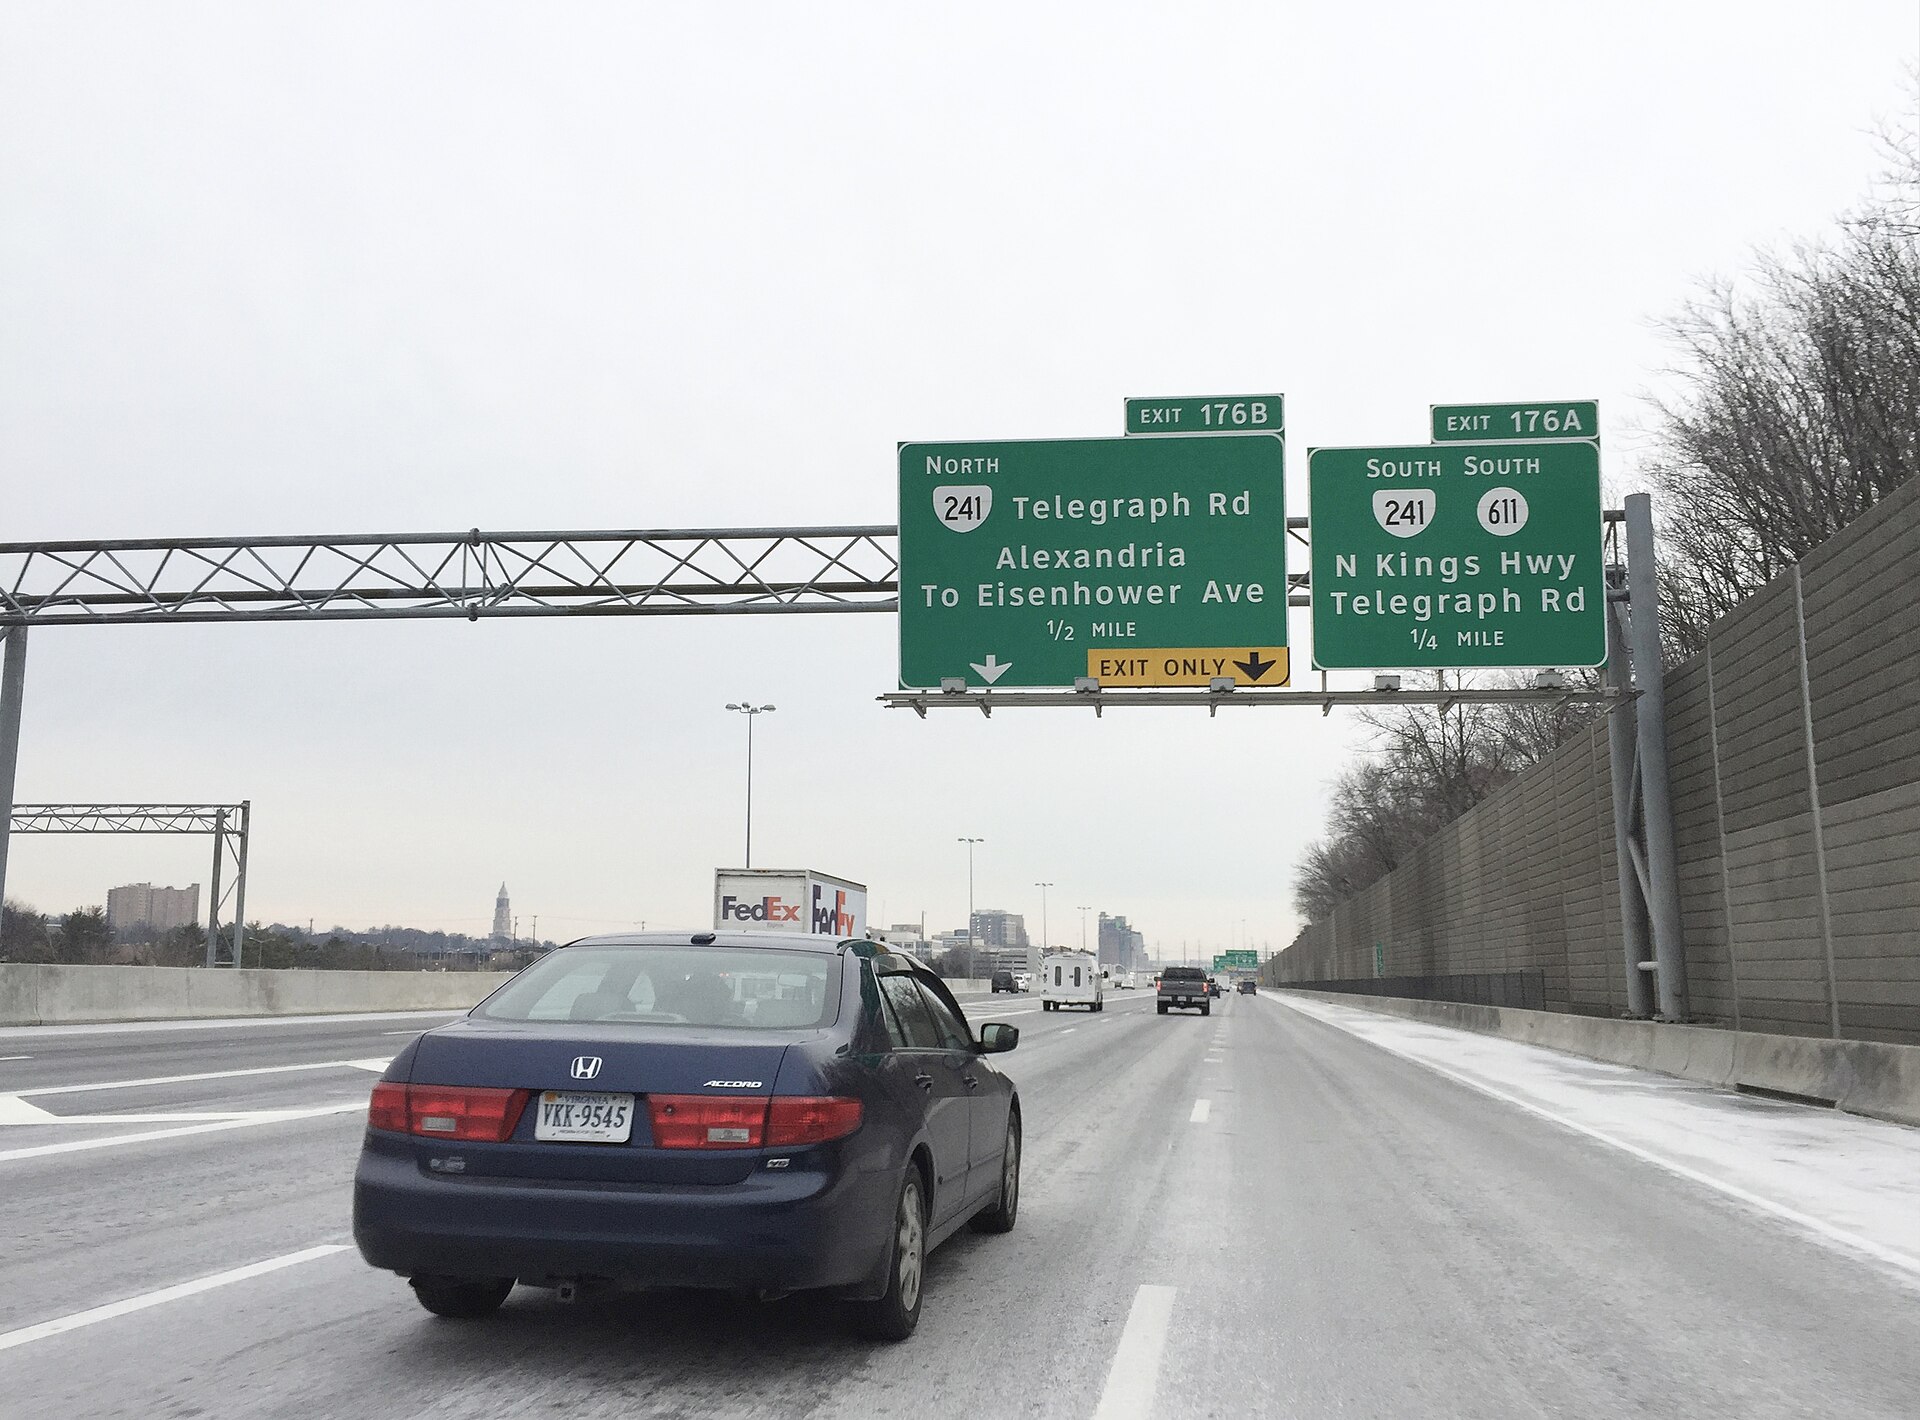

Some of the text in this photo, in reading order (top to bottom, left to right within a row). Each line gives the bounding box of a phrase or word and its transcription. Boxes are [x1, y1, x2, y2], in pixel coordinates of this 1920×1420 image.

[1140, 403, 1268, 425] EXIT 176B
[1447, 409, 1582, 432] EXIT 176A
[926, 456, 999, 474] NORTH
[1366, 456, 1540, 478] SOUTH SOUTH
[944, 491, 1250, 524] 241 Telegraph Rd
[1385, 500, 1424, 526] 241
[1488, 498, 1517, 524] 611
[996, 542, 1186, 570] Alexandria
[1336, 552, 1576, 582] N Kings Hwy
[921, 580, 1264, 607] To Eisenhower Ave
[1330, 587, 1585, 621] Telegraph Rd
[1047, 620, 1136, 641] 1/2 MILE
[1411, 628, 1504, 650] 1/4 MILE
[1100, 658, 1225, 677] EXIT ONLY
[722, 896, 800, 921] FedEx
[703, 1080, 763, 1088] ACCORD
[544, 1104, 627, 1128] VKK-9545
